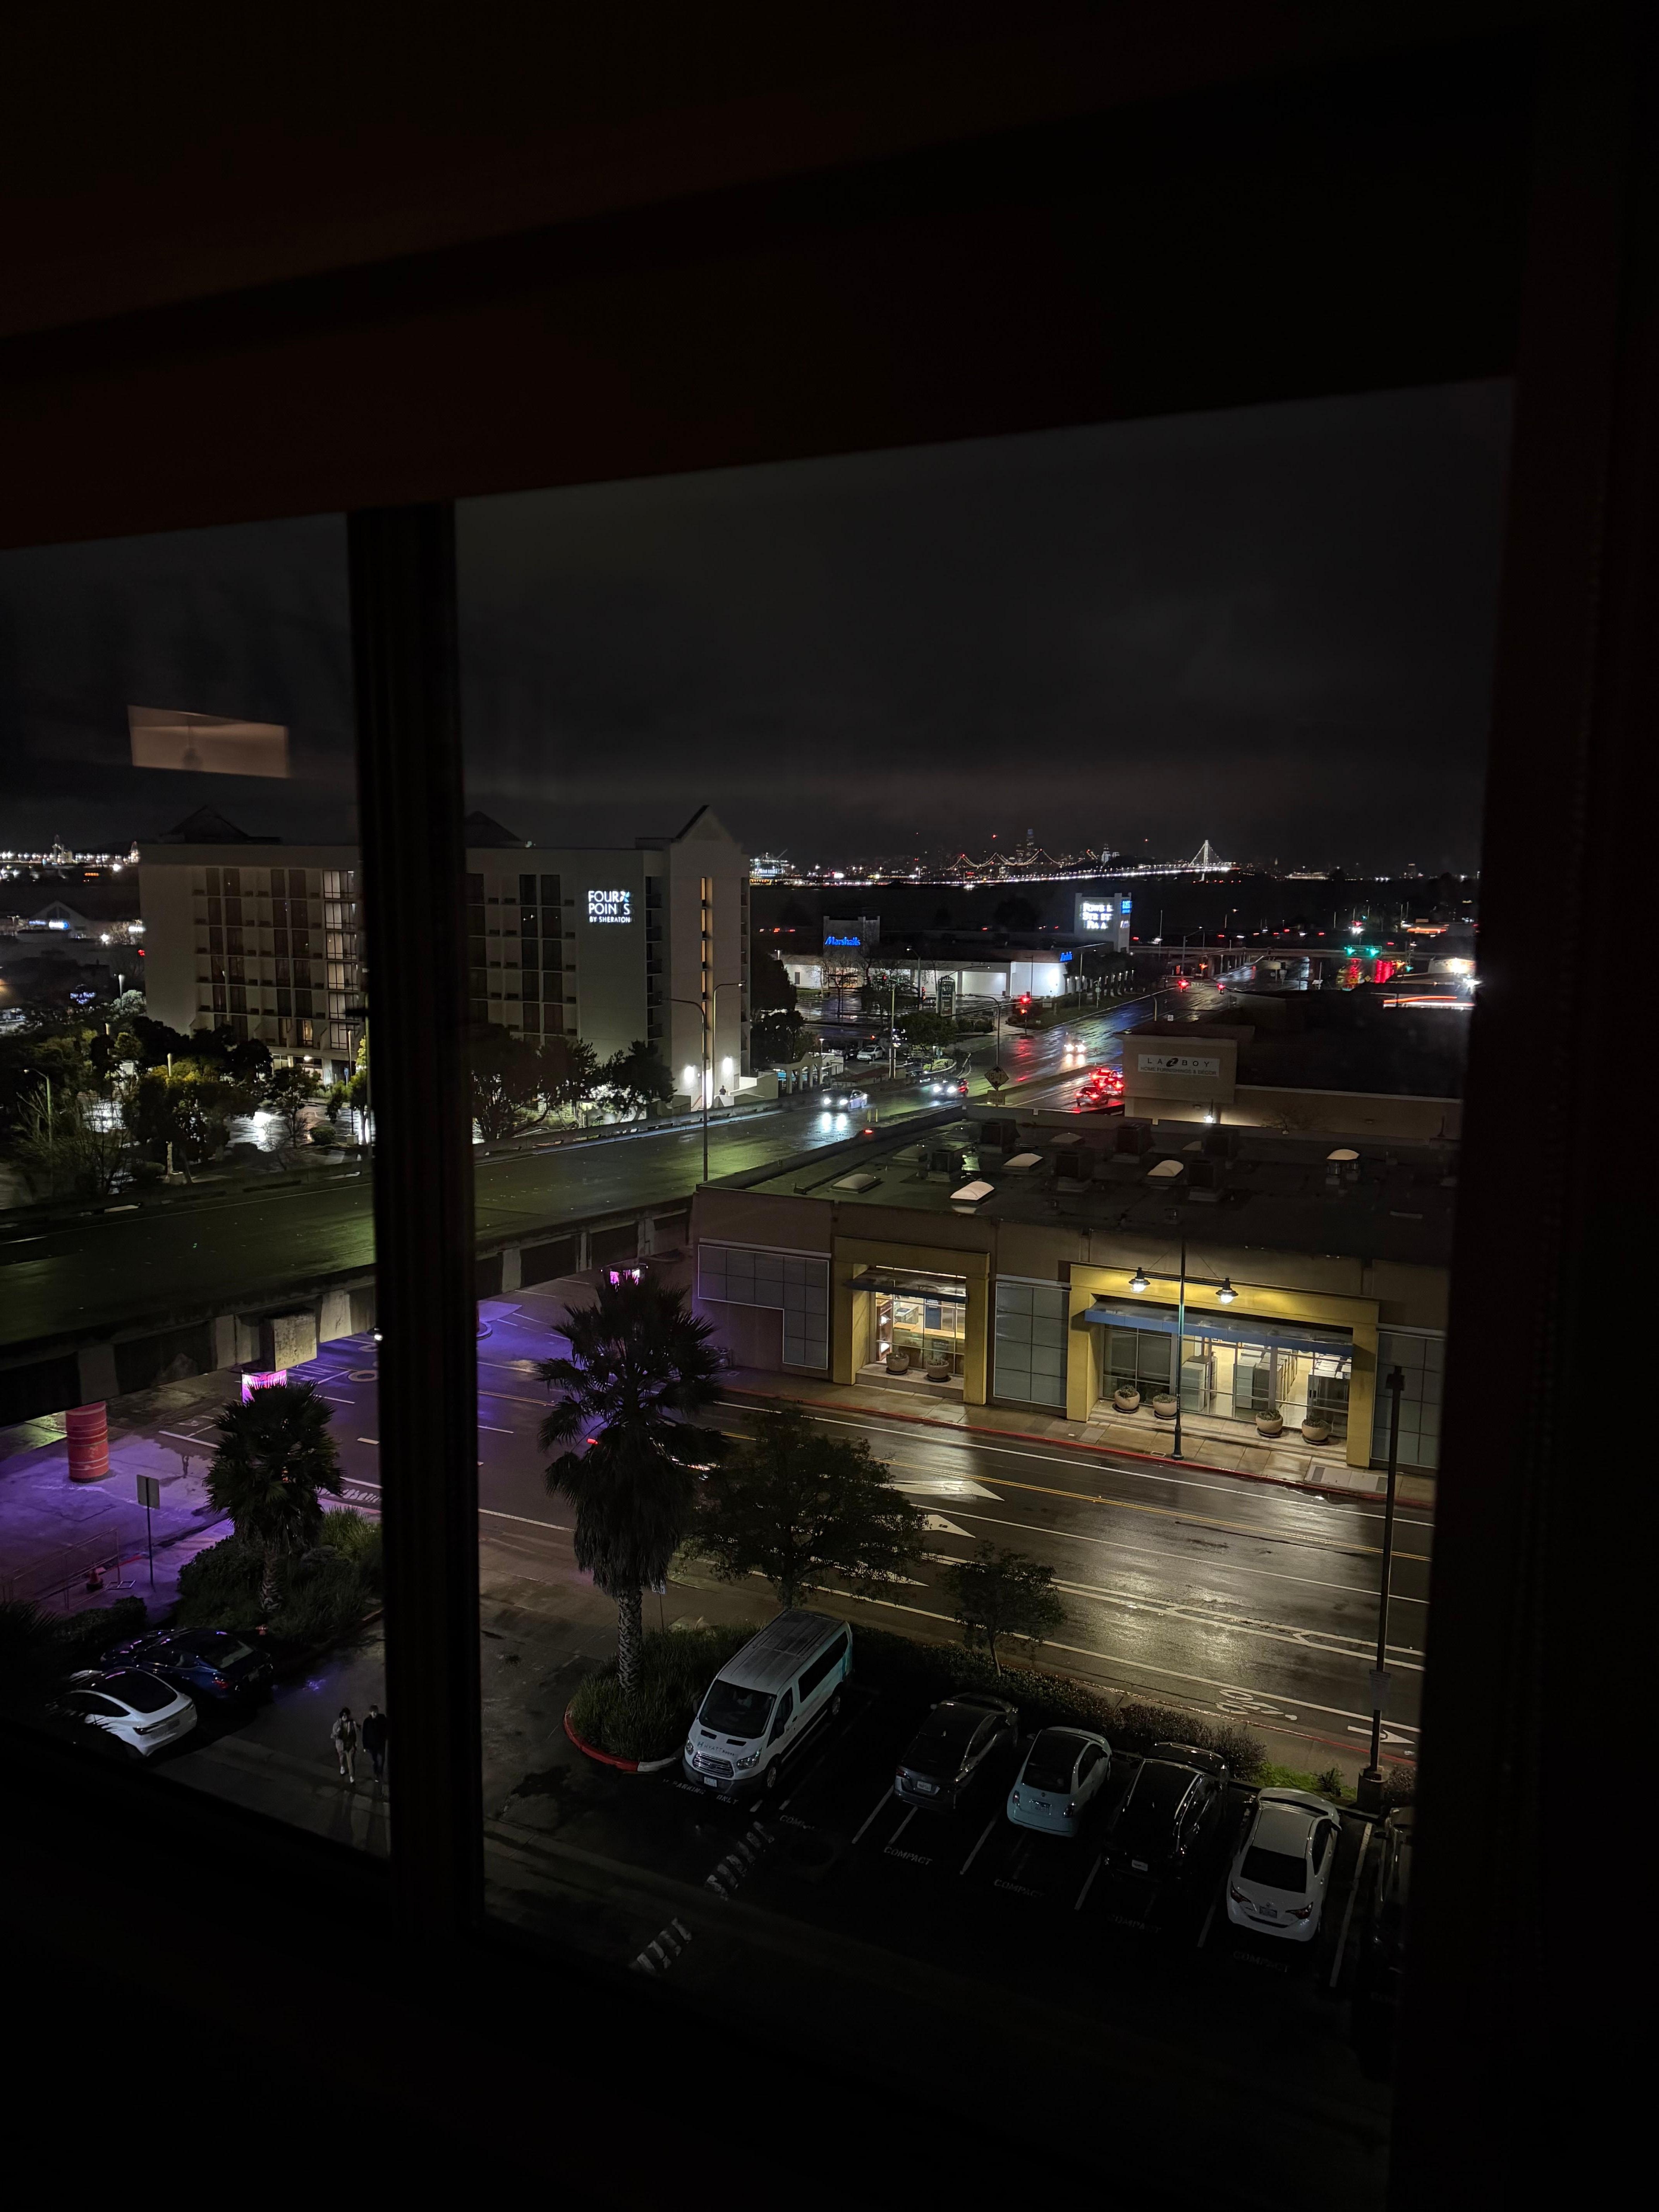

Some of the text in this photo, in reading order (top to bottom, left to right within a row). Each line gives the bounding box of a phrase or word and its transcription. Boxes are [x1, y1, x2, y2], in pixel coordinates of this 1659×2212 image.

[588, 890, 620, 902] FOUR
[589, 903, 630, 915] POINS
[825, 936, 860, 945] Marshalls
[672, 1781, 706, 1795] PARKING
[716, 1794, 739, 1805] ONLY
[883, 1846, 933, 1865] COMPACT
[994, 1879, 1046, 1898] COMPACT
[1108, 1914, 1162, 1934] OMPAT
